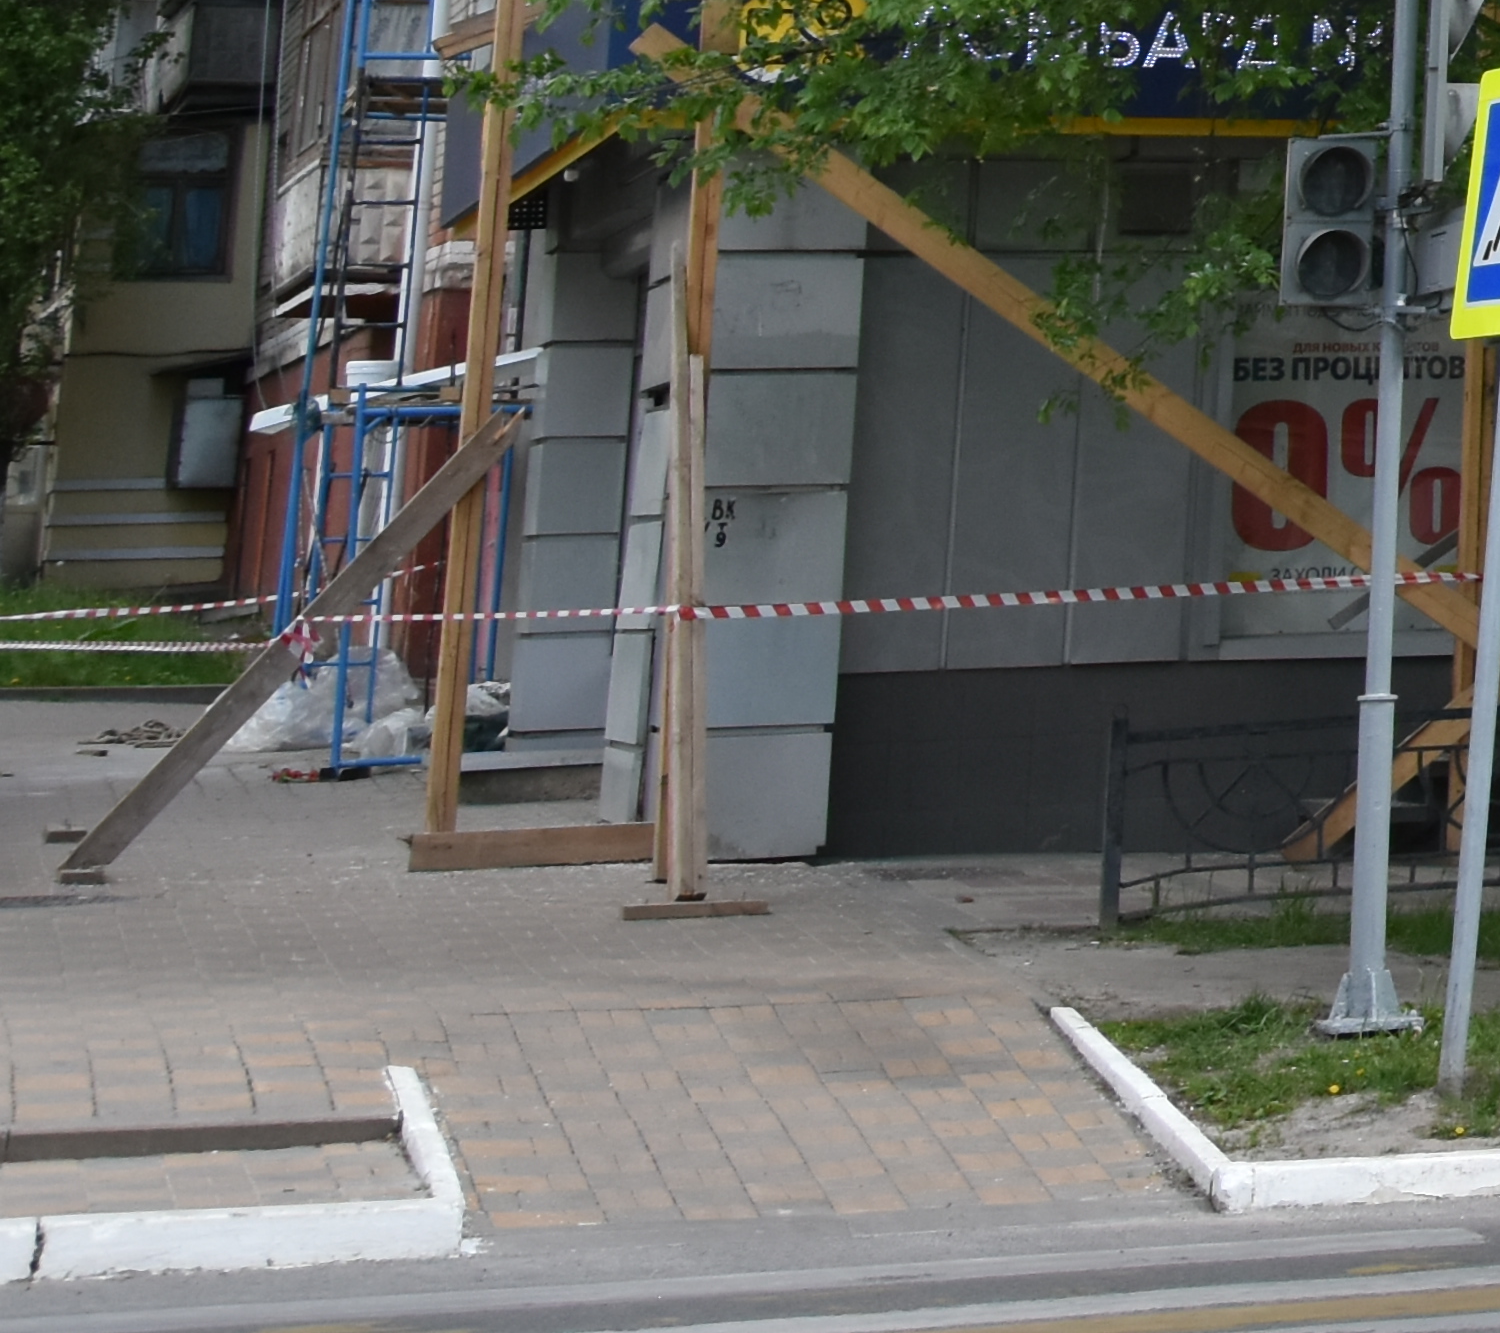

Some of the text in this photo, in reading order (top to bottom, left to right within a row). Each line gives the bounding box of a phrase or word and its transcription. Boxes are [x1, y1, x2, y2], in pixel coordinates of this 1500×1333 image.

[1292, 342, 1321, 354] ДЛЯ
[1323, 341, 1369, 354] НОВЫХ
[1233, 355, 1466, 385] БЕЗ ПРОЦТОВ
